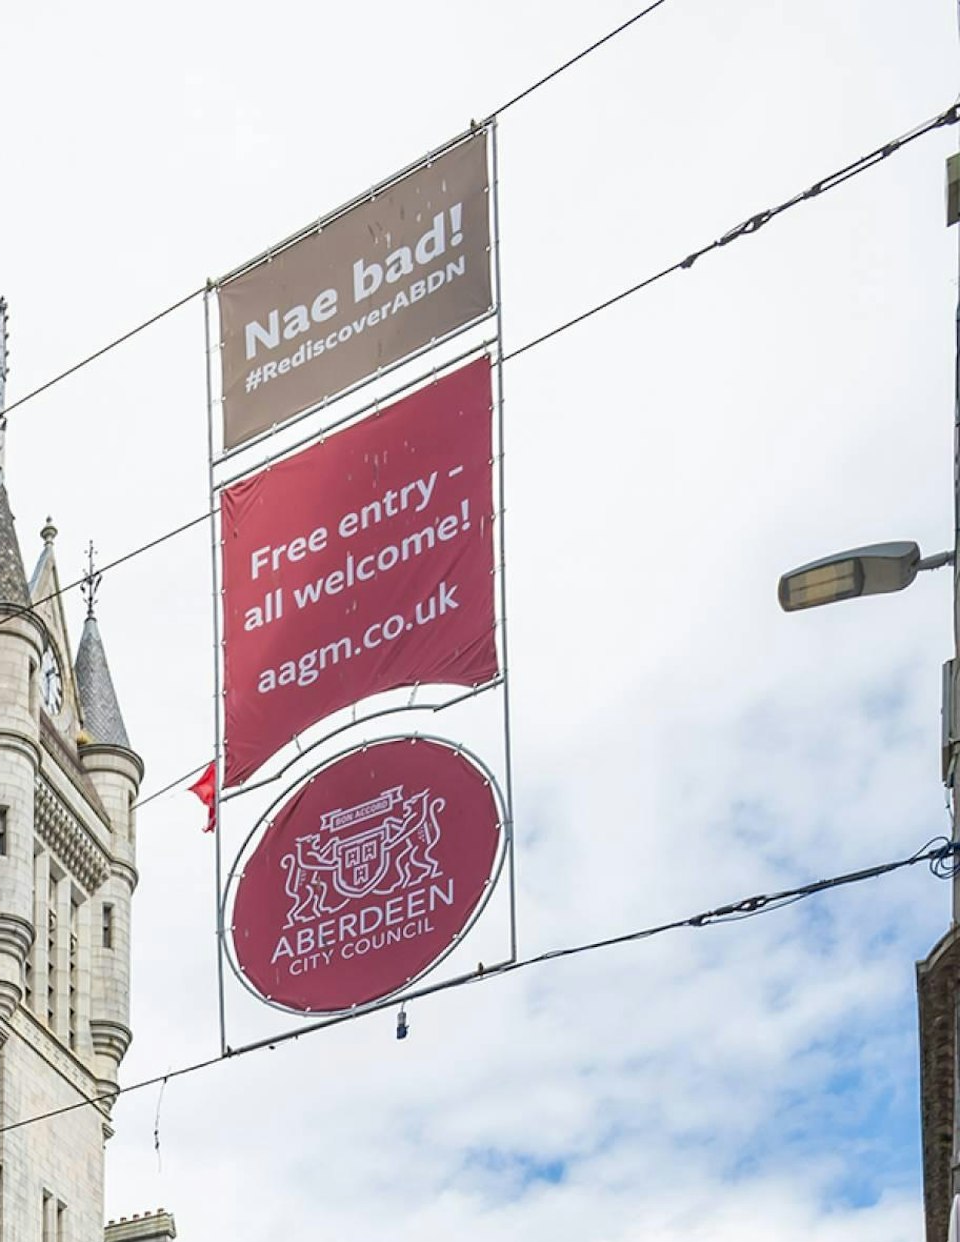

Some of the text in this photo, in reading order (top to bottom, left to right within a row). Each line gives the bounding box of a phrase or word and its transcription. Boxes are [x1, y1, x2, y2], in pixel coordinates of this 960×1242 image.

[245, 202, 464, 360] Nae bad!
[245, 255, 465, 393] #RediscoverABDN
[243, 499, 471, 631] all welcome!
[251, 526, 328, 580] Free
[338, 471, 438, 538] entry
[257, 582, 460, 694] aagm.co.uk
[335, 812, 354, 826] BON
[270, 879, 454, 964] ABERDEEN
[289, 917, 434, 976] CITY COUNCIL
